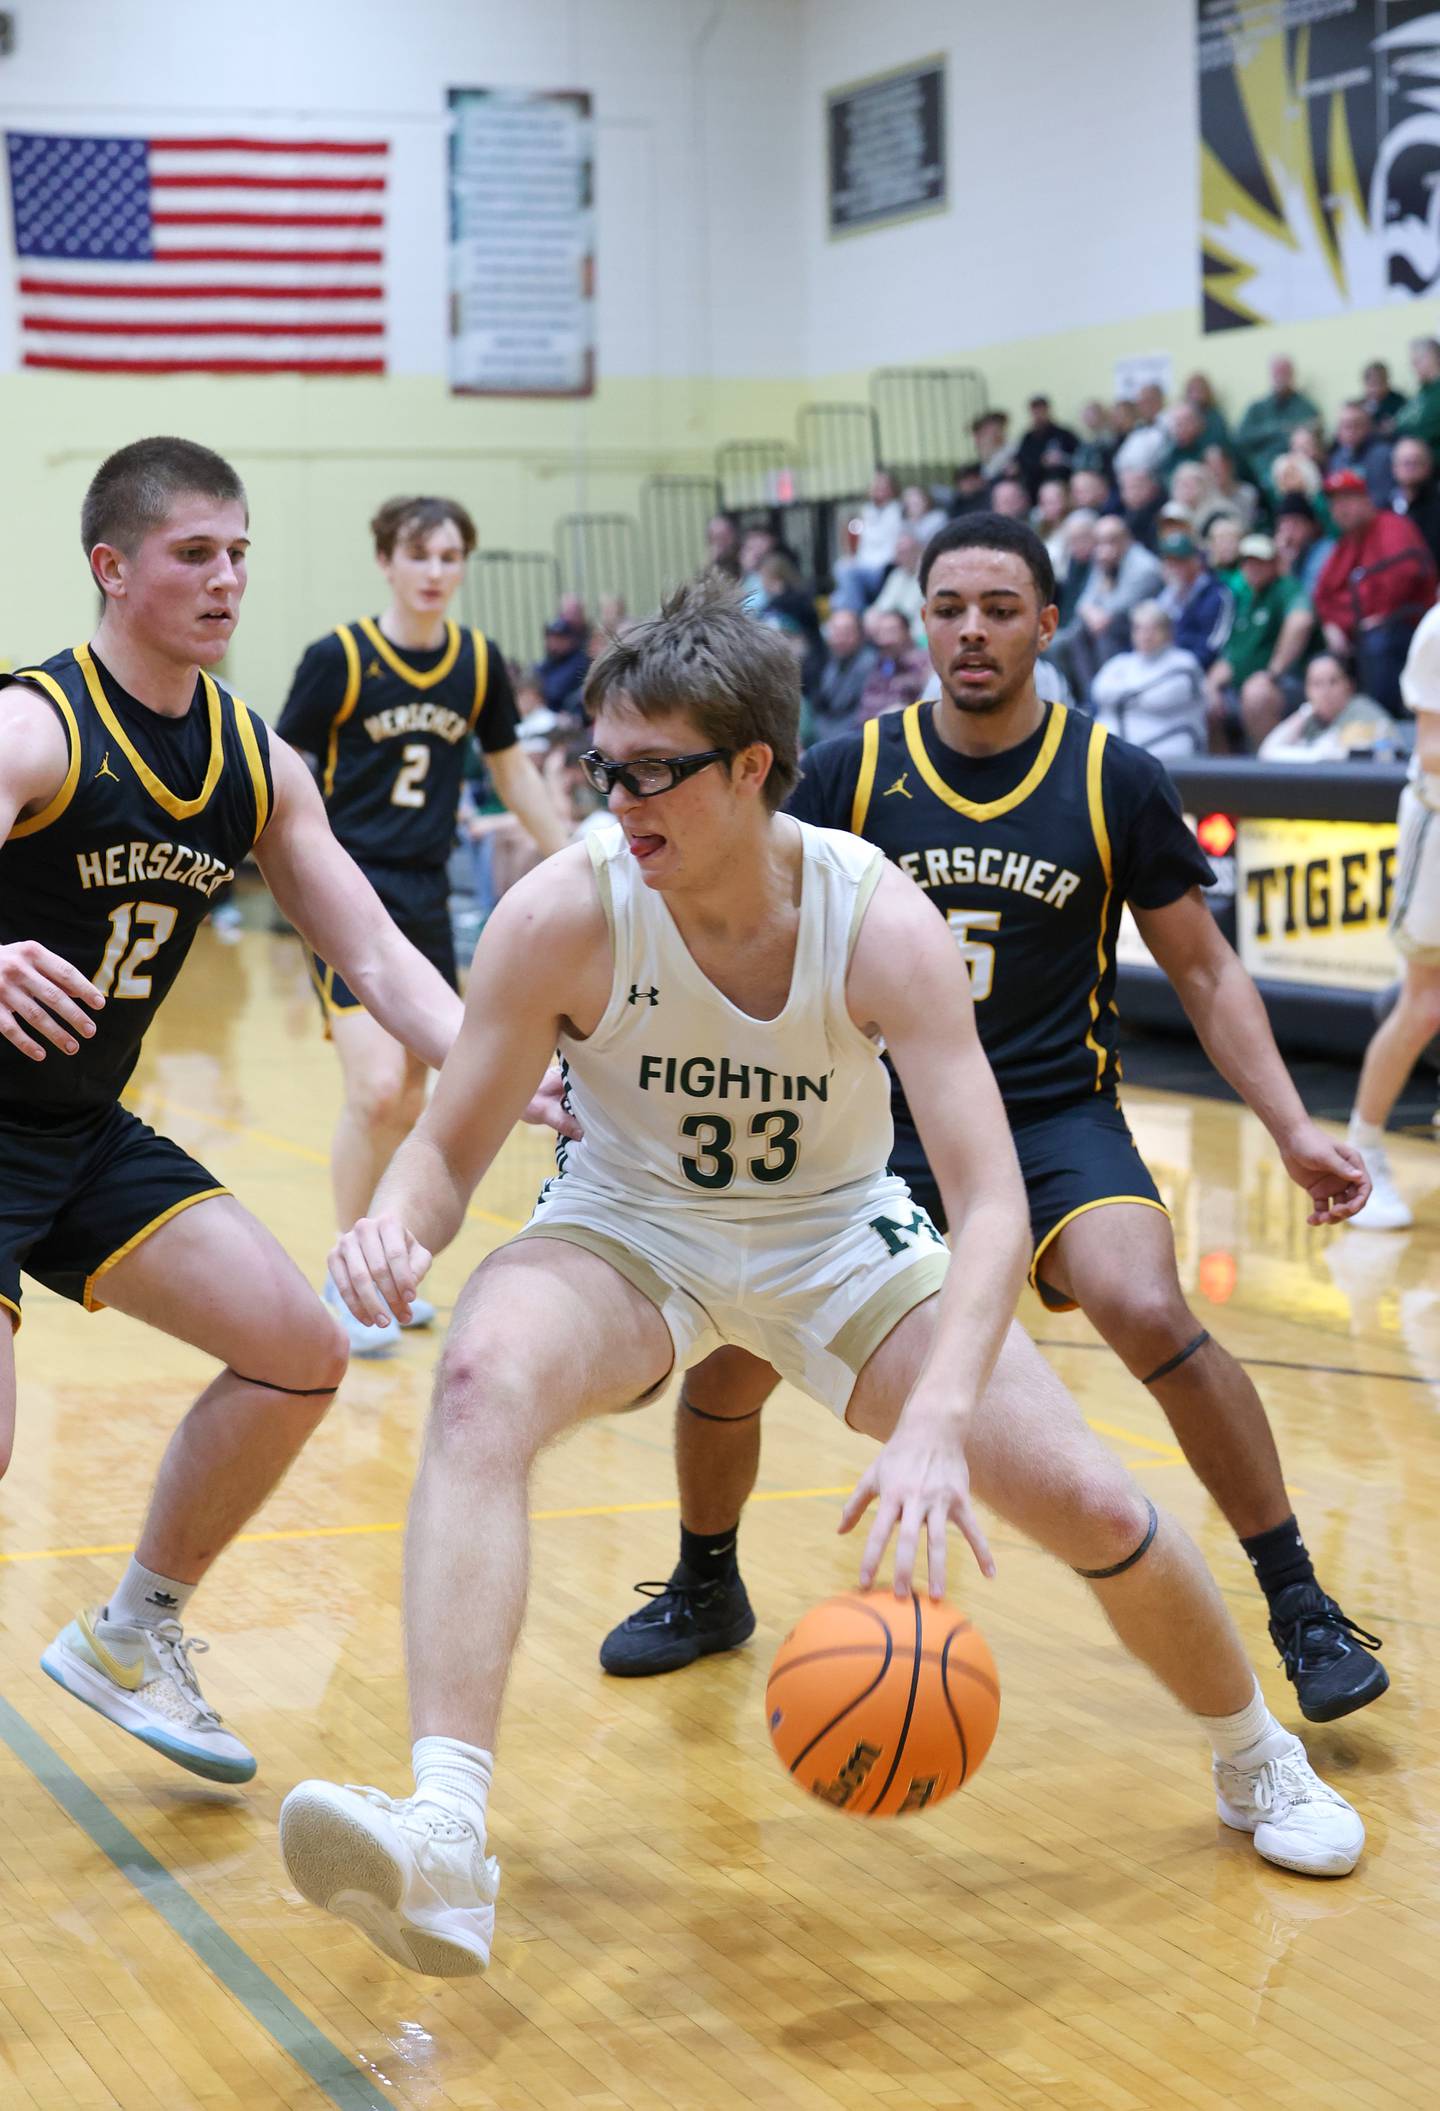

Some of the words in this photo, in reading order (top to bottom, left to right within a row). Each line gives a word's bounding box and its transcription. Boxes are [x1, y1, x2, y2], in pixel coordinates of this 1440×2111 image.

[391, 744, 430, 808] 2
[899, 846, 1081, 909] ERSCHER
[92, 901, 179, 998] 12
[947, 908, 1001, 1002] 5
[679, 1109, 802, 1189] 33
